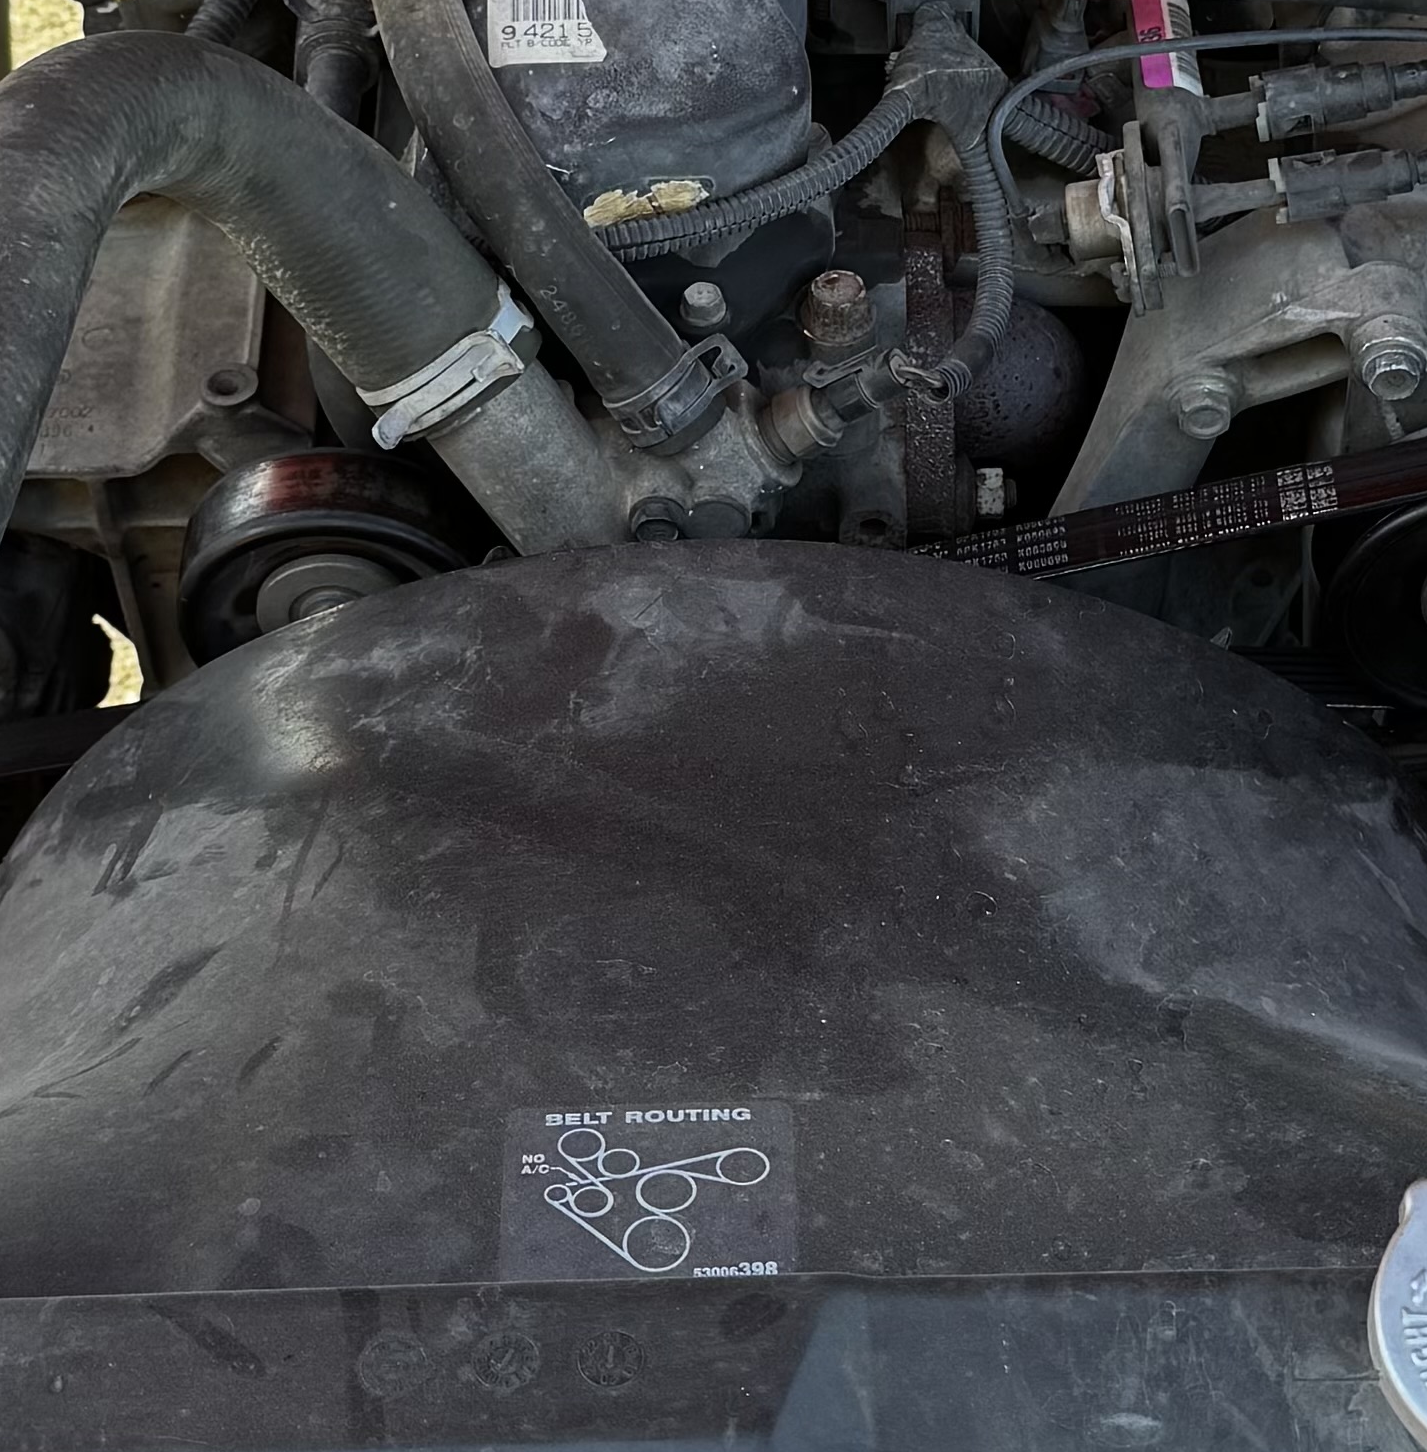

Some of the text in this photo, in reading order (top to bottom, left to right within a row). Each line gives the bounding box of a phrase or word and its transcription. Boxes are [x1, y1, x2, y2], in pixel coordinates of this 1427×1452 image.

[545, 1108, 752, 1127] BELT ROUTING
[522, 1154, 546, 1165] NO
[521, 1164, 551, 1175] A/C
